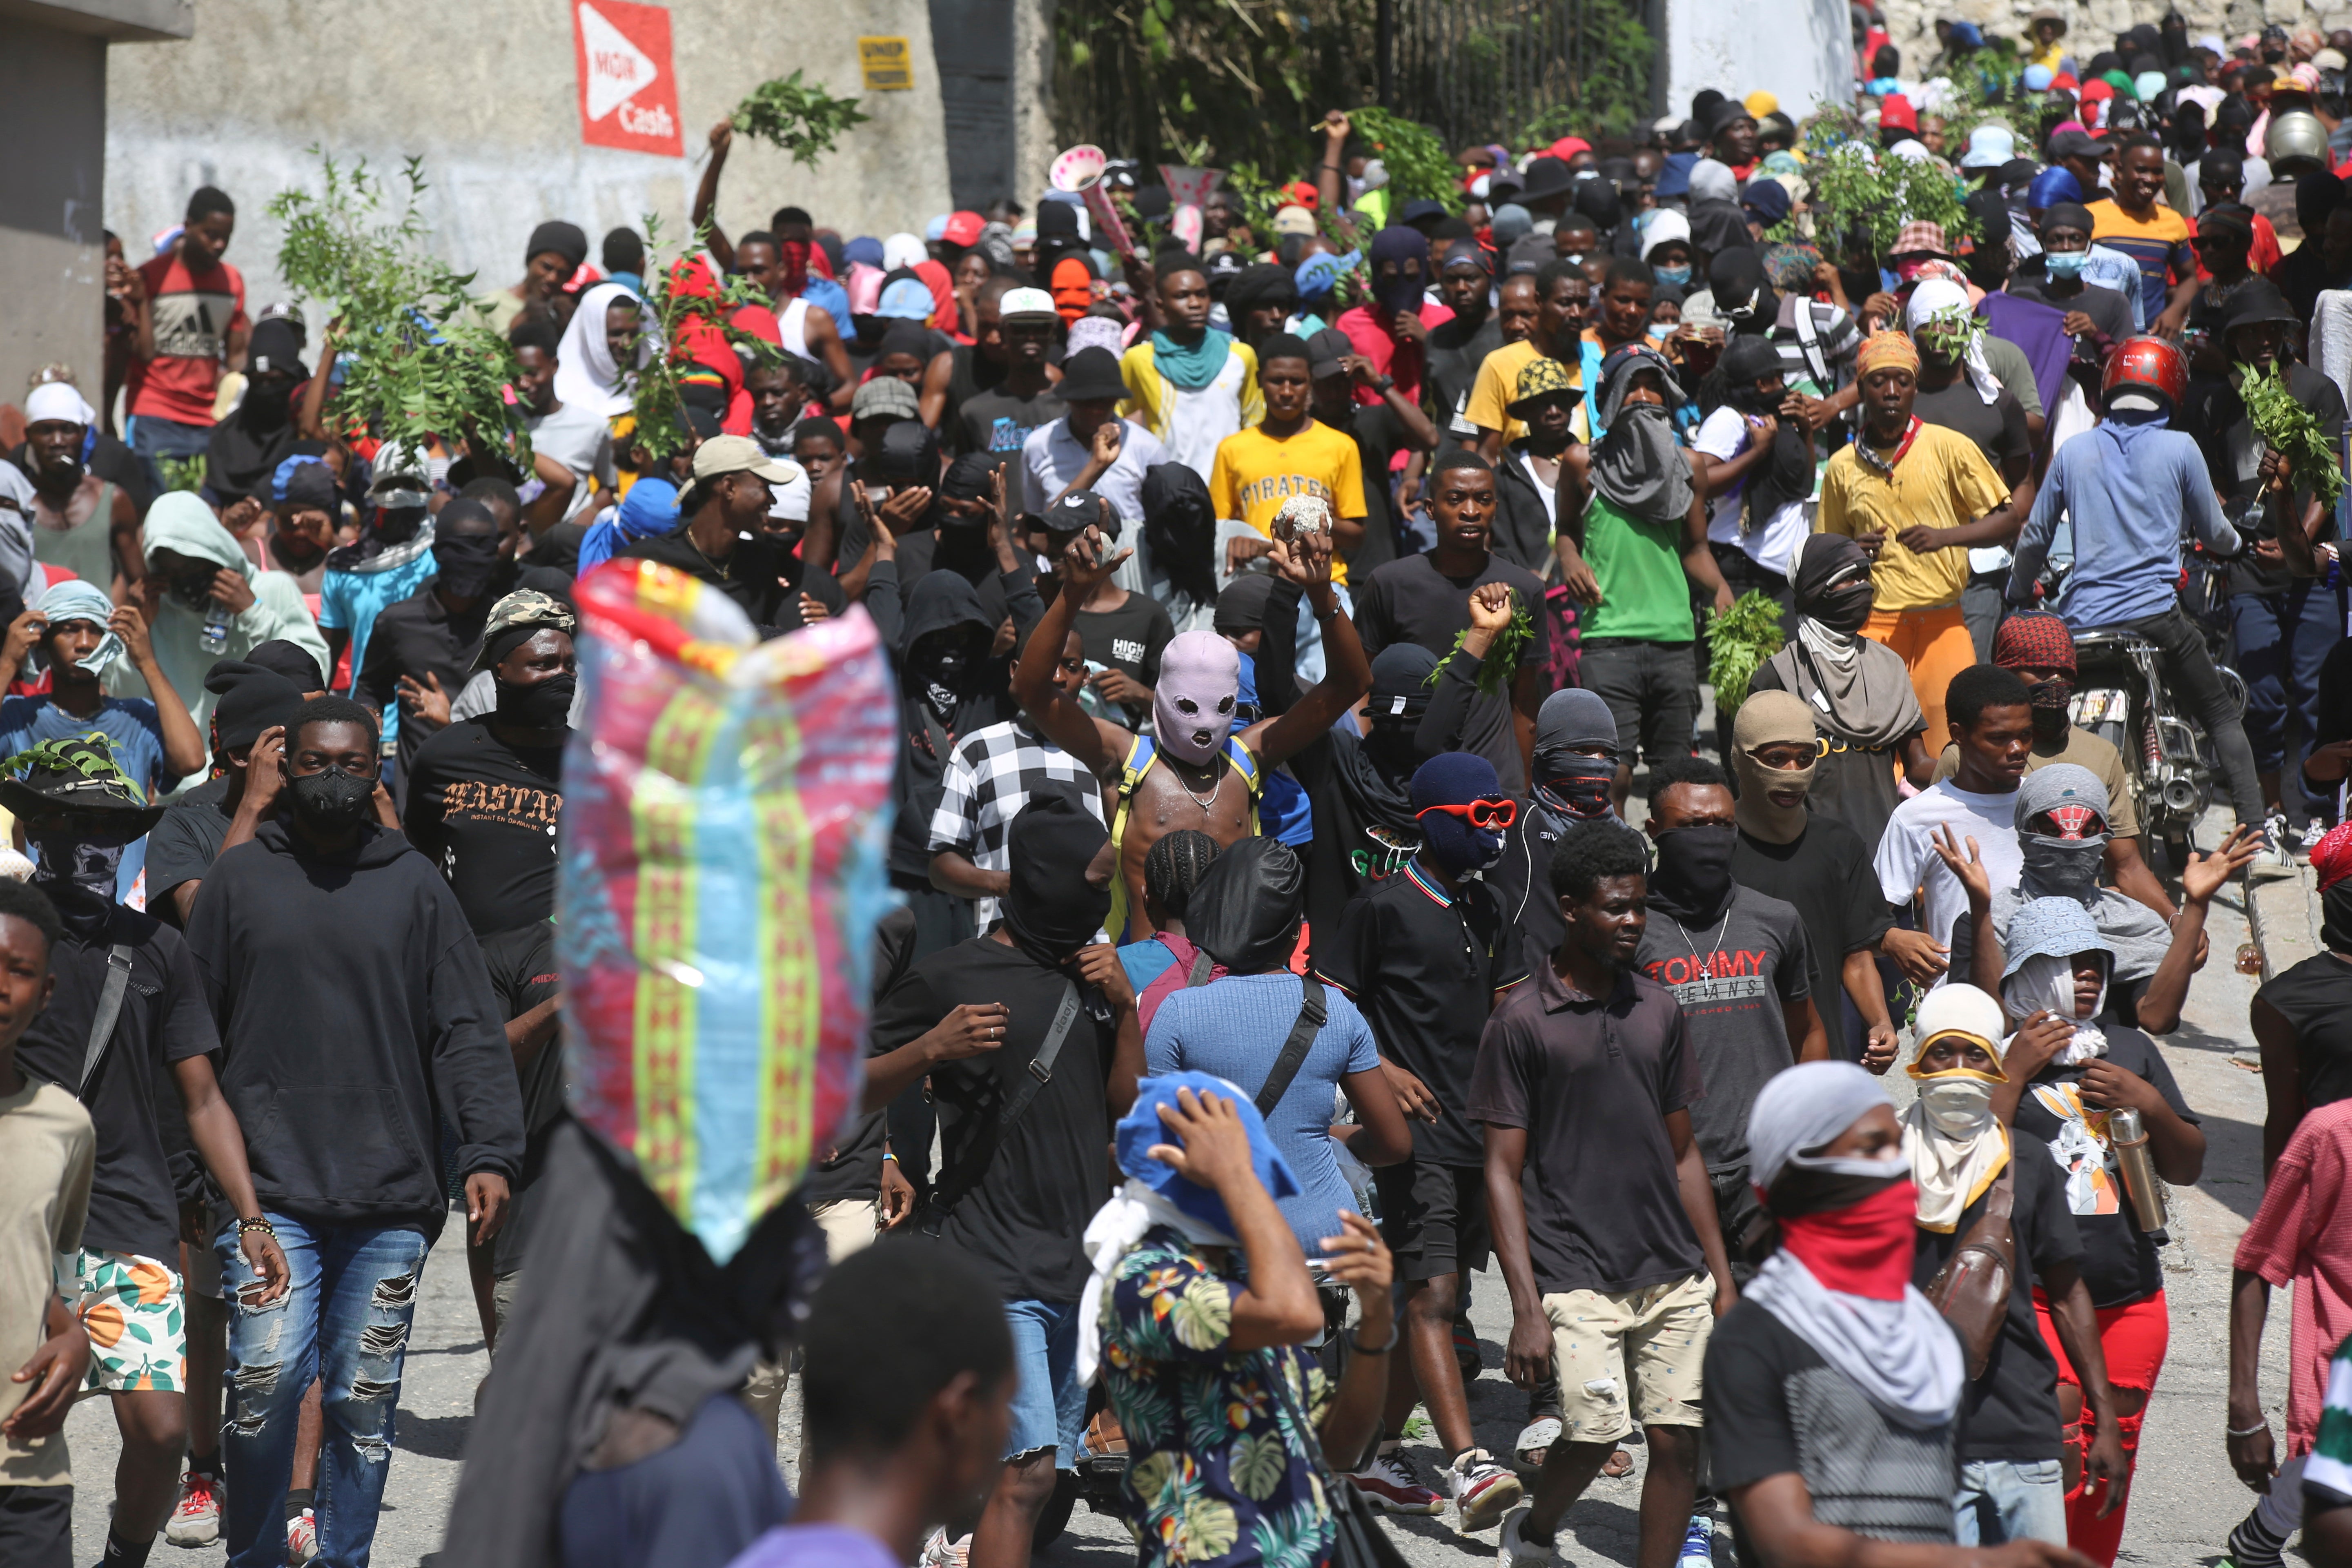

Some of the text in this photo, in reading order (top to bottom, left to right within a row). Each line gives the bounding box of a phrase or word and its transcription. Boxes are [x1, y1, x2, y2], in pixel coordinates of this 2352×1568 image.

[618, 102, 674, 138] Cash
[1112, 638, 1146, 658] HIGH
[1644, 950, 1766, 985] TOMMY
[1670, 980, 1756, 1002] EANS
[1056, 998, 1076, 1034] Jeep
